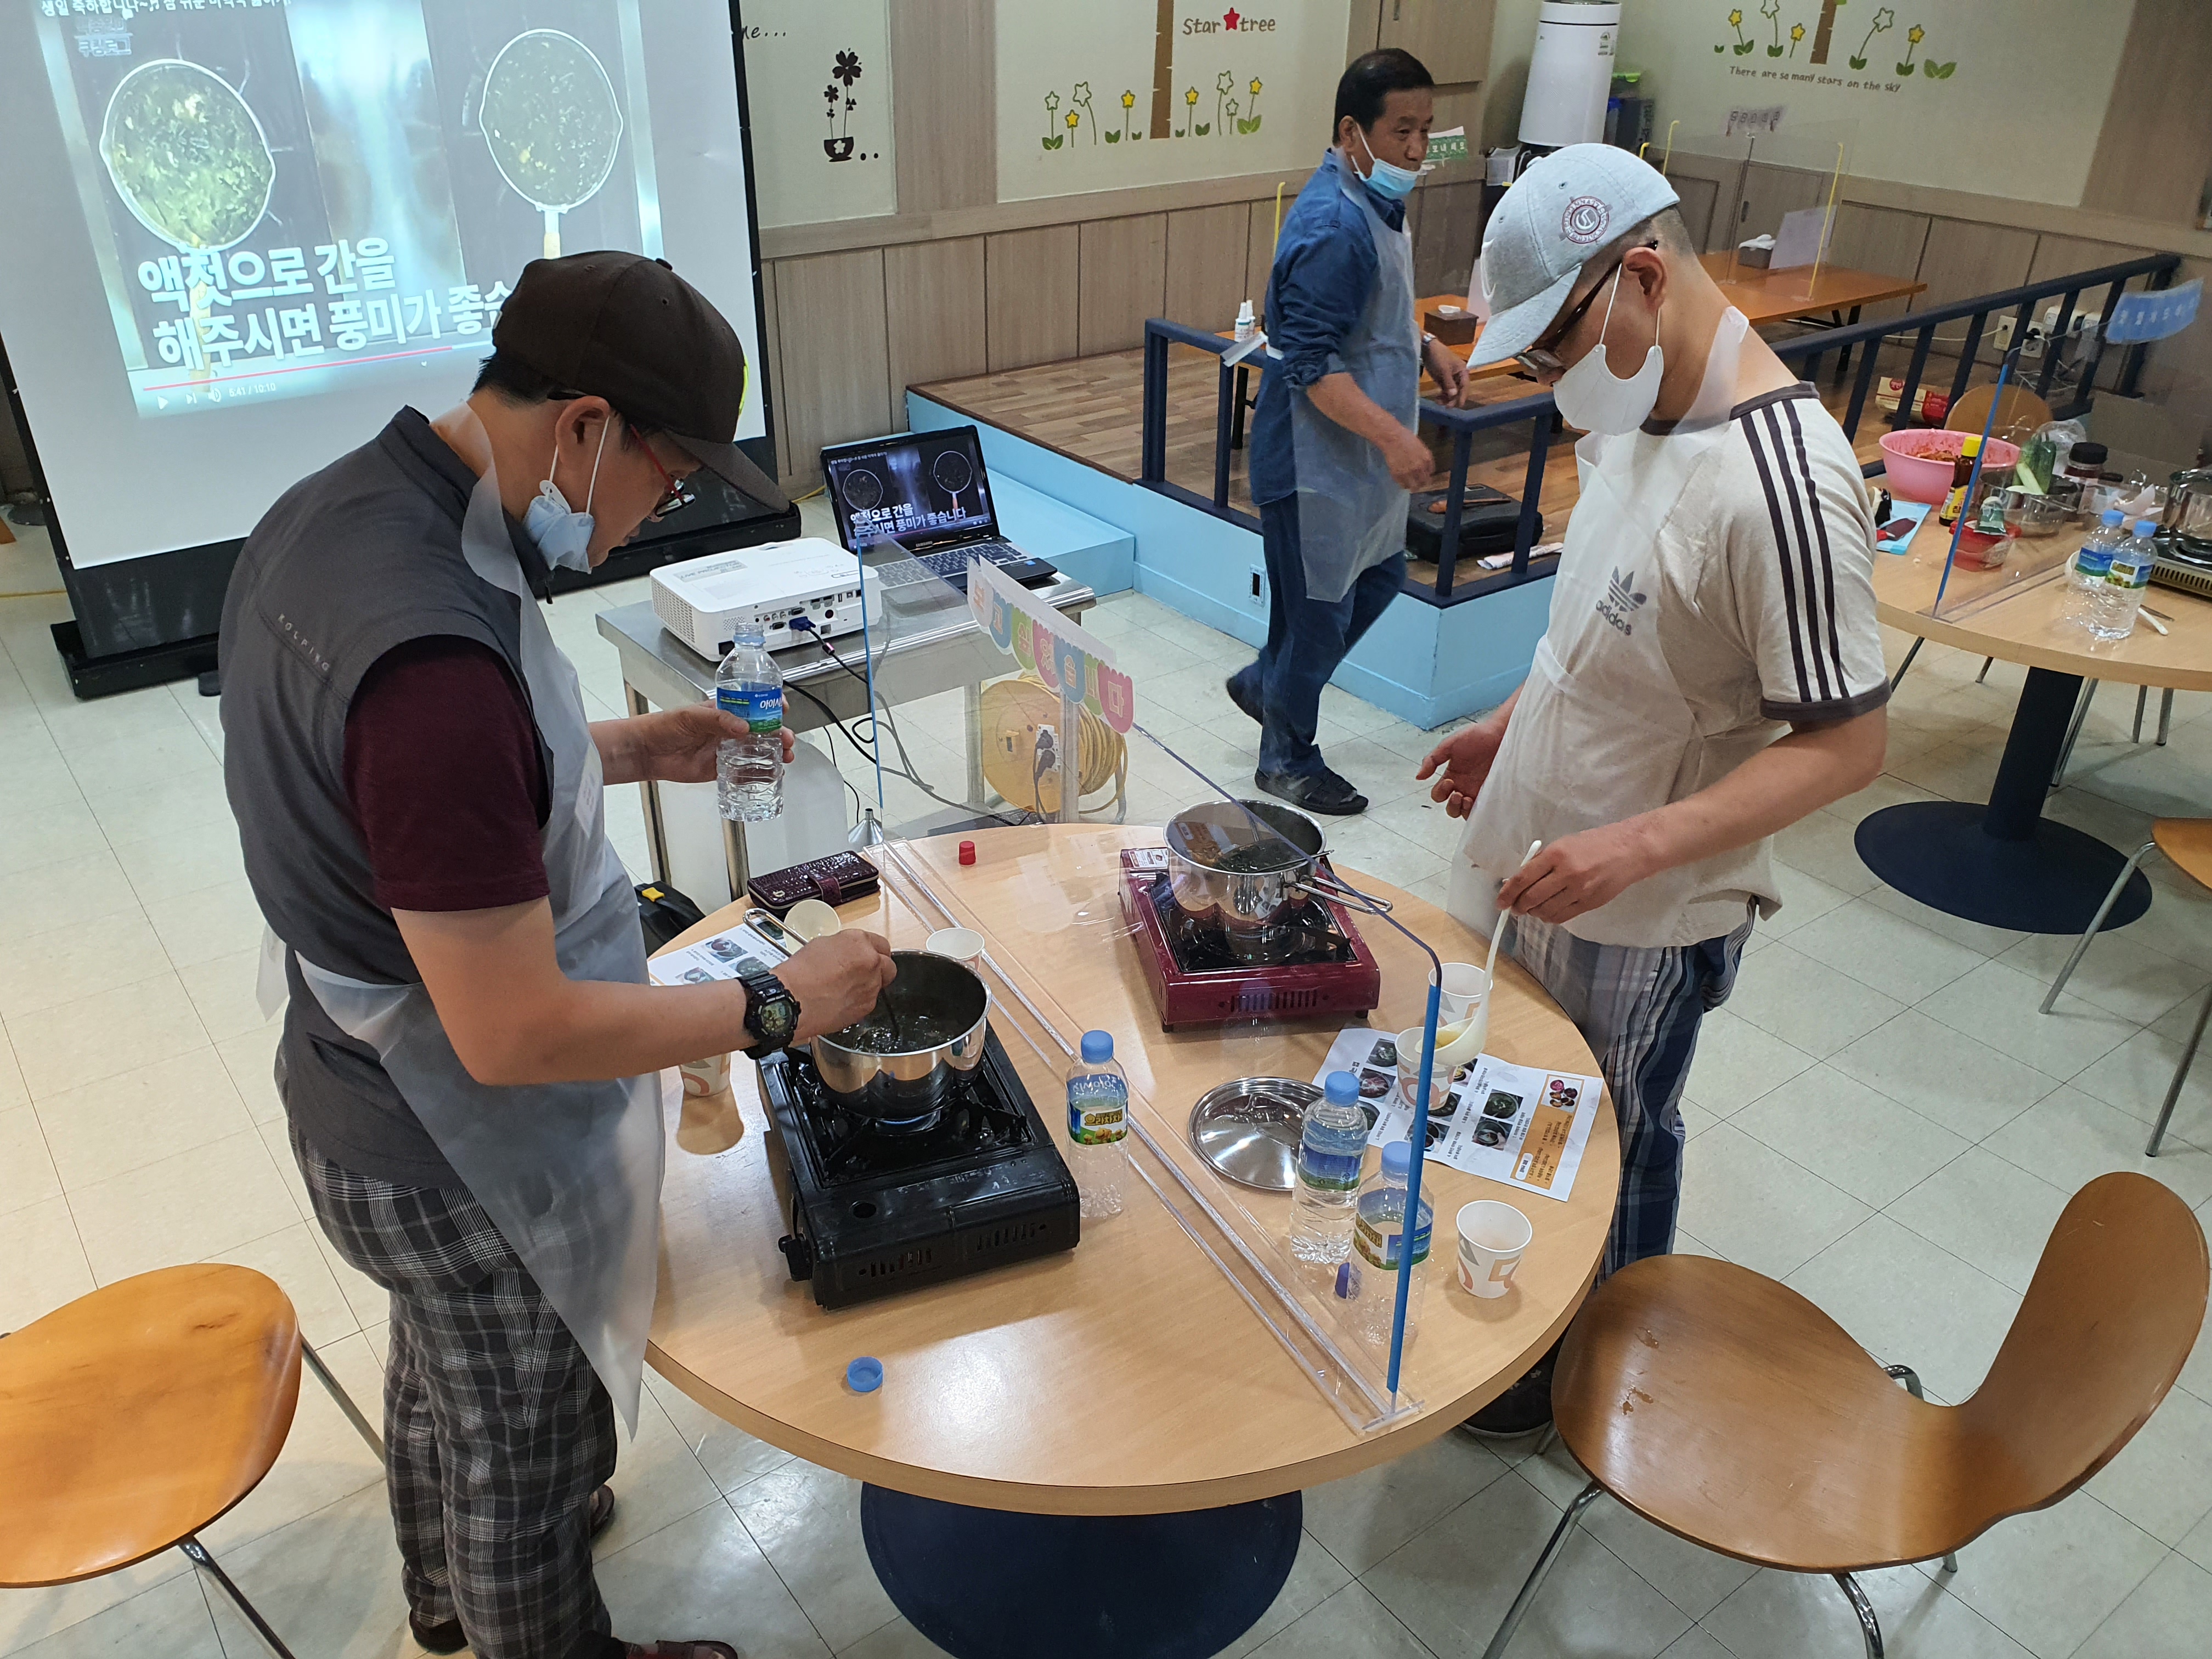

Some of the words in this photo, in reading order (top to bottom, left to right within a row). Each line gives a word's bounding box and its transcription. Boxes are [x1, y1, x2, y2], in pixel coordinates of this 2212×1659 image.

[1183, 18, 1221, 35] Star
[1239, 17, 1276, 32] tree
[1730, 66, 1756, 77] There
[1780, 72, 1789, 80] so
[1791, 73, 1815, 82] many
[1817, 76, 1842, 87] stars
[1863, 81, 1881, 91] the
[1884, 83, 1901, 93] sky
[314, 236, 396, 295] 간을
[153, 302, 325, 370] 해주시면
[328, 289, 442, 352] 풍미가
[896, 515, 927, 532] 풍미가
[927, 506, 967, 526] 좋습니다
